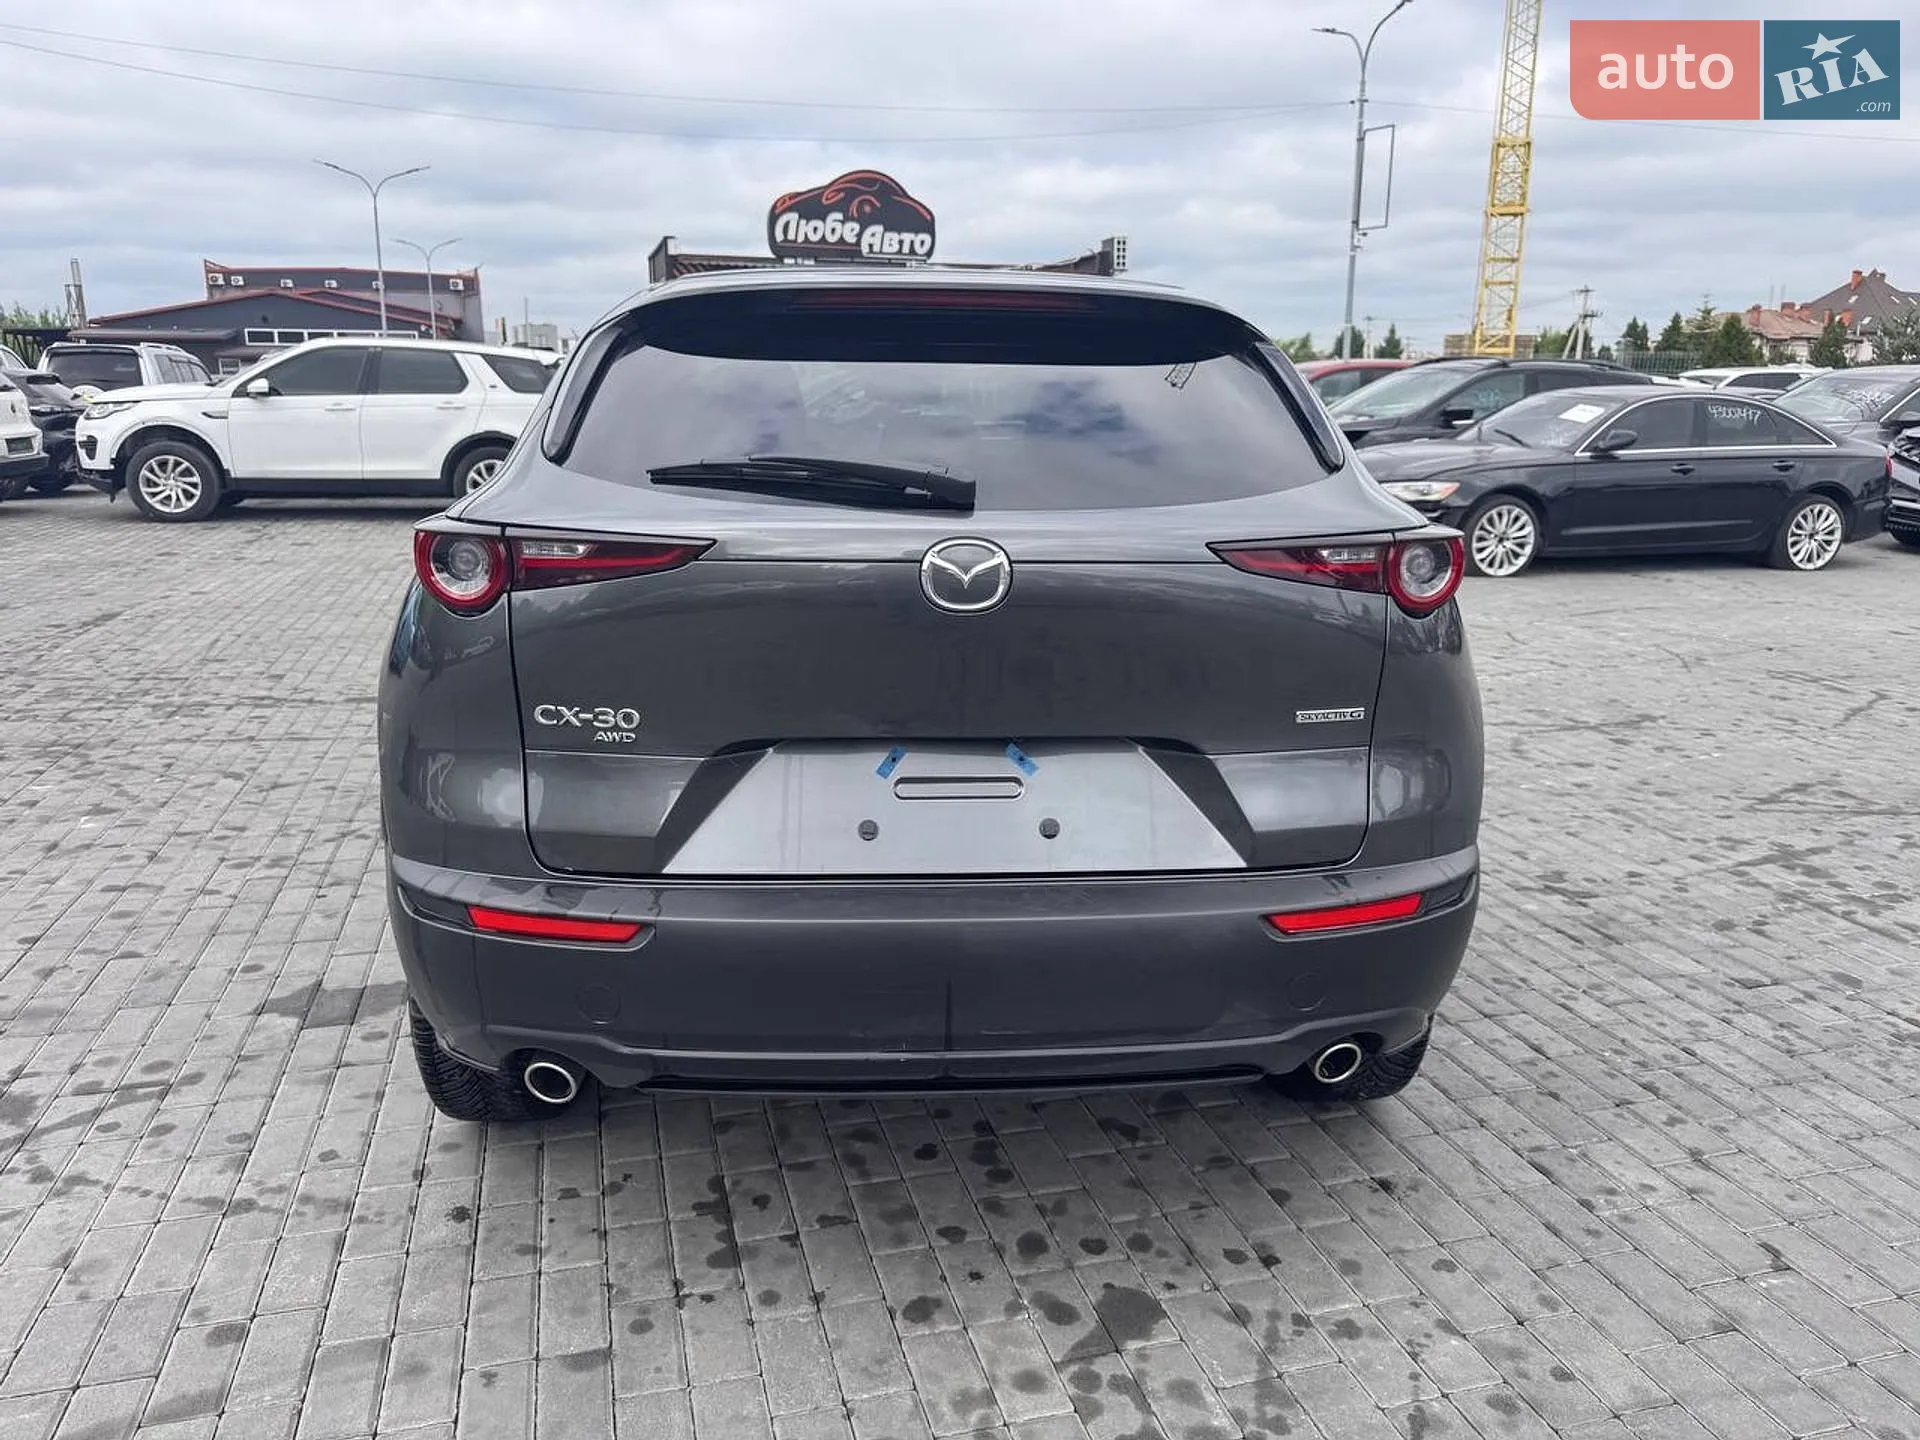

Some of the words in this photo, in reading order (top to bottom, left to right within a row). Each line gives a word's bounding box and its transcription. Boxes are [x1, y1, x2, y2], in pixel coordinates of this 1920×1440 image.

[774, 212, 860, 244] Любе
[861, 224, 933, 256] Авто
[534, 704, 640, 729] CX-30
[593, 731, 636, 743] AWD
